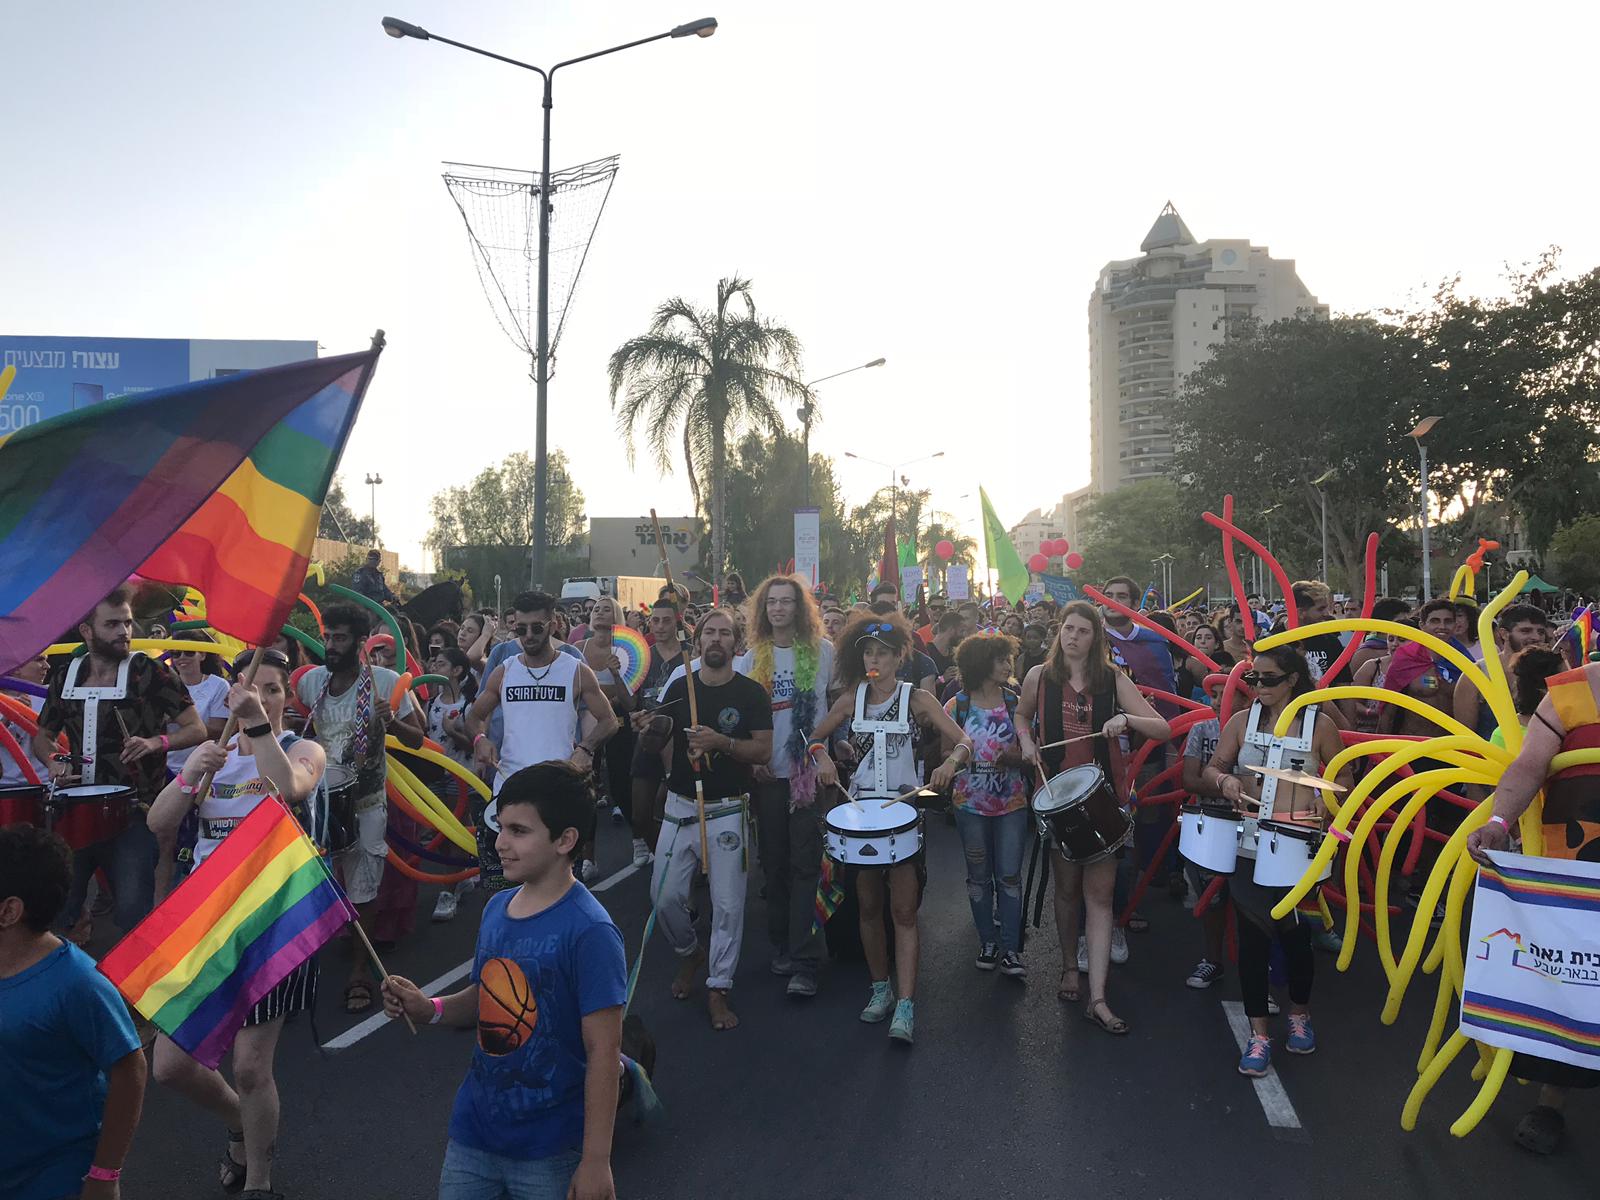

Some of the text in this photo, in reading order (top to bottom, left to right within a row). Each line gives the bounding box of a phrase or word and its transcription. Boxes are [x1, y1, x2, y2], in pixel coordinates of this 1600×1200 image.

[72, 350, 120, 369] עצור!
[635, 524, 670, 533] מללת
[1530, 942, 1600, 967] בית גאה
[1534, 958, 1599, 981] בבאר-שבע
